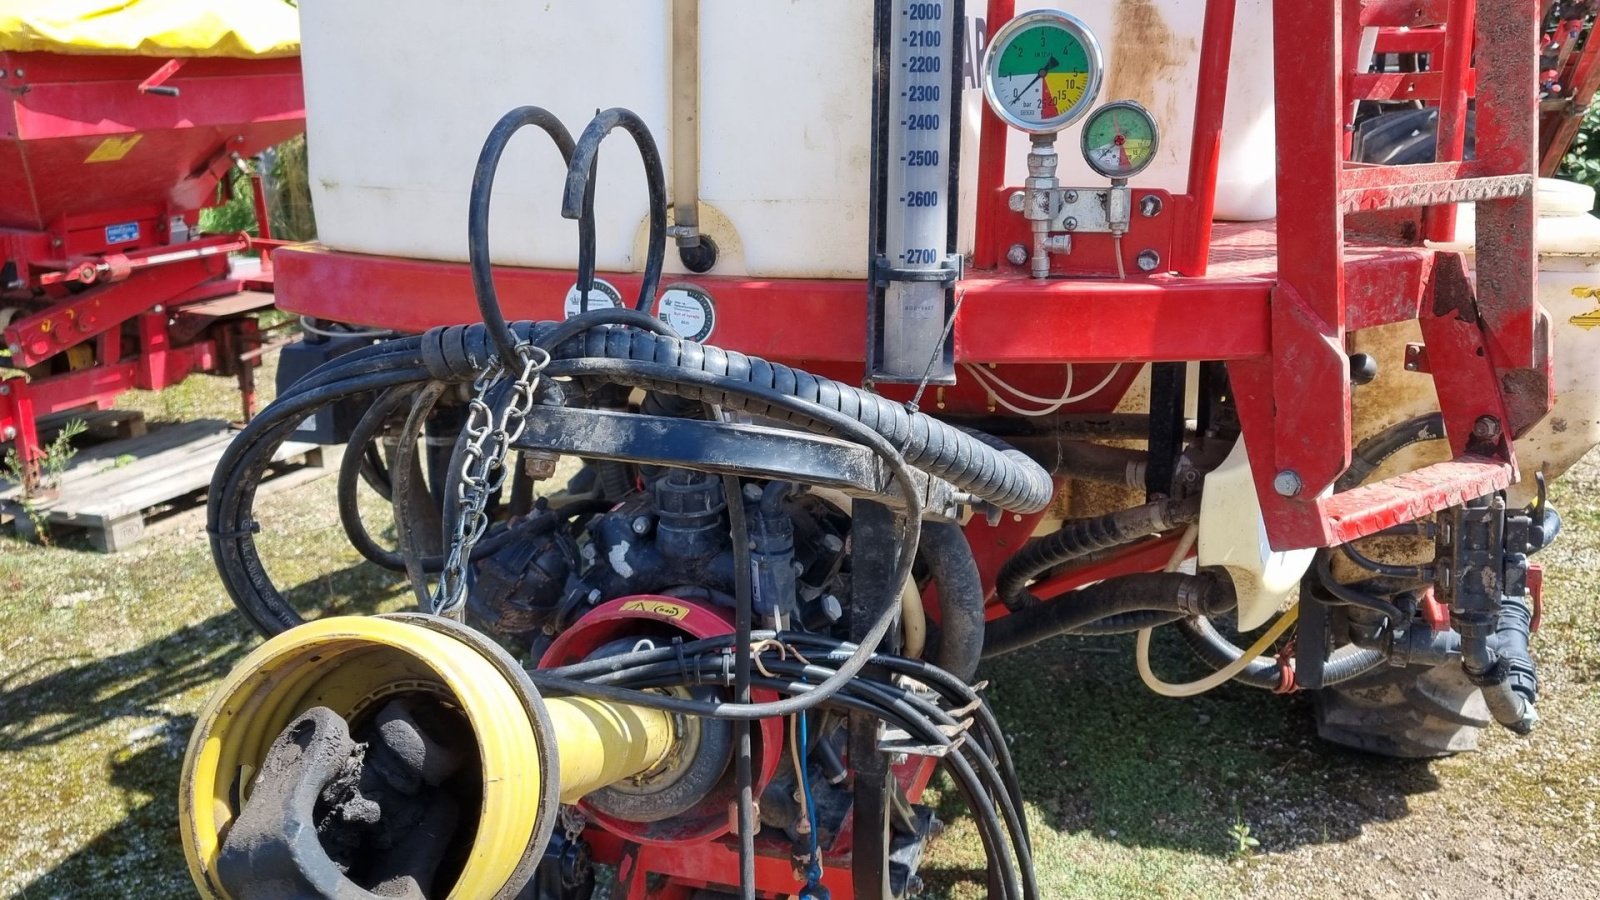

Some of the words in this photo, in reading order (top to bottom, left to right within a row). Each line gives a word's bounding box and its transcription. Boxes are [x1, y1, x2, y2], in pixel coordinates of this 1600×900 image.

[909, 3, 942, 20] 2000
[909, 30, 941, 47] 2100
[909, 56, 941, 73] 2200
[1066, 79, 1075, 89] 10
[908, 85, 940, 102] 2300
[1057, 90, 1067, 100] 15
[908, 114, 940, 130] 2400
[908, 150, 939, 166] 2500
[907, 191, 938, 207] 2600
[906, 248, 937, 264] 2700
